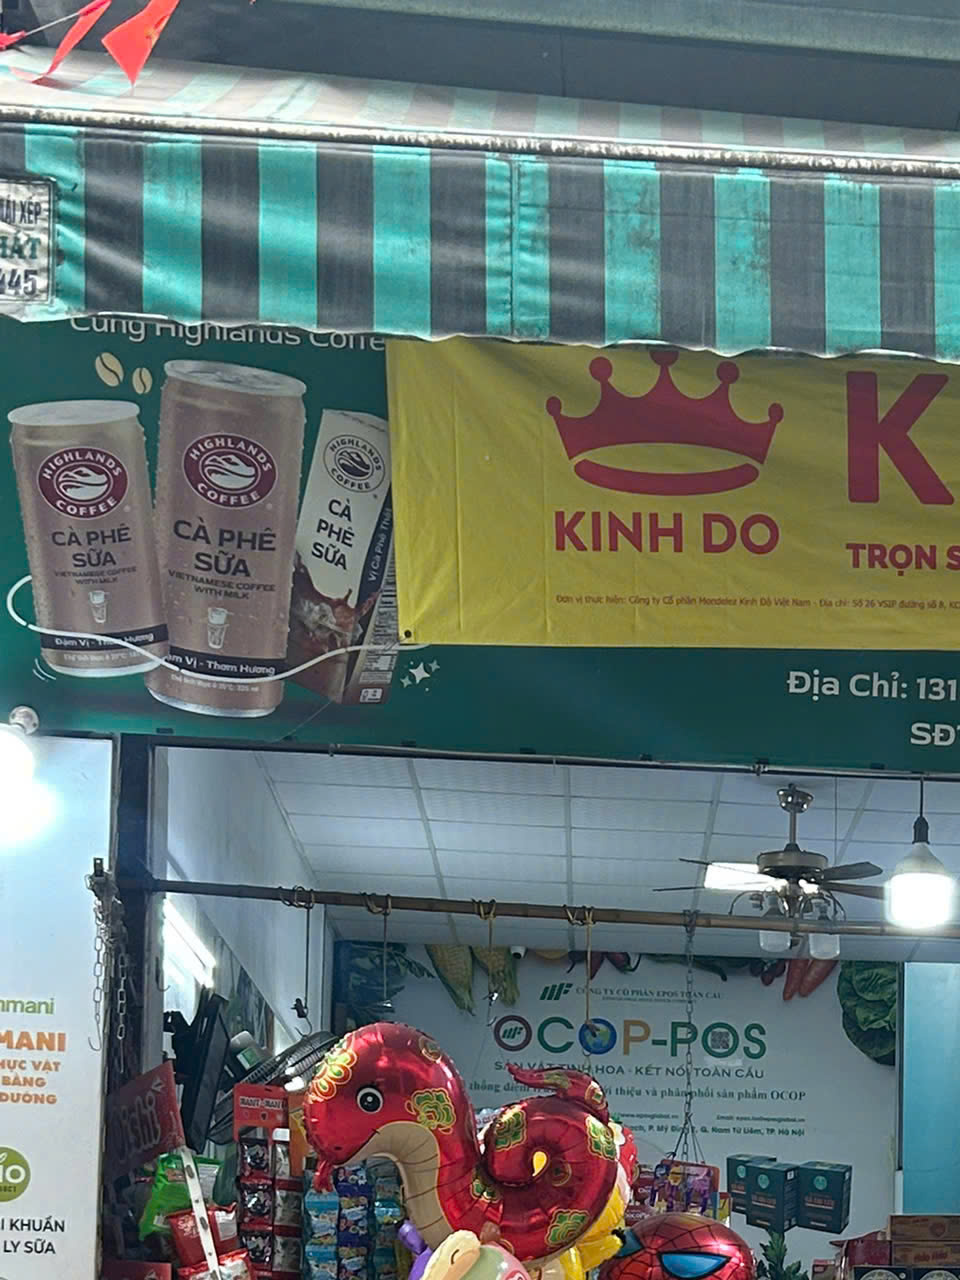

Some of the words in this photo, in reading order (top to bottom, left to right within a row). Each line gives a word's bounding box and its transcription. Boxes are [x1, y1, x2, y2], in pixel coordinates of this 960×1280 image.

[43, 450, 122, 479] HIGHLANDS
[188, 437, 272, 472] HIGHLANDS
[330, 438, 382, 471] HIGHLANDS
[331, 468, 370, 490] COFFEE
[56, 496, 117, 516] COFFEE
[196, 482, 261, 505] COFFEE
[328, 496, 352, 522] CÀ
[52, 526, 81, 546] CÀ
[87, 523, 132, 546] PHÊ
[173, 516, 211, 545] CÀ
[218, 527, 277, 551] PHÊ
[317, 518, 355, 548] PHÊ
[554, 511, 684, 554] KINH
[702, 513, 781, 555] DO
[72, 549, 116, 568] SỮA
[194, 550, 251, 577] SỮA
[312, 542, 348, 570] SỮA
[845, 543, 938, 578] TRỌN
[787, 670, 840, 700] Địa
[850, 671, 908, 701] Chỉ:
[916, 676, 960, 703] 131
[493, 1015, 767, 1060] OCOP-POS
[594, 1065, 625, 1075] HOA
[770, 1090, 806, 1101] OCOP
